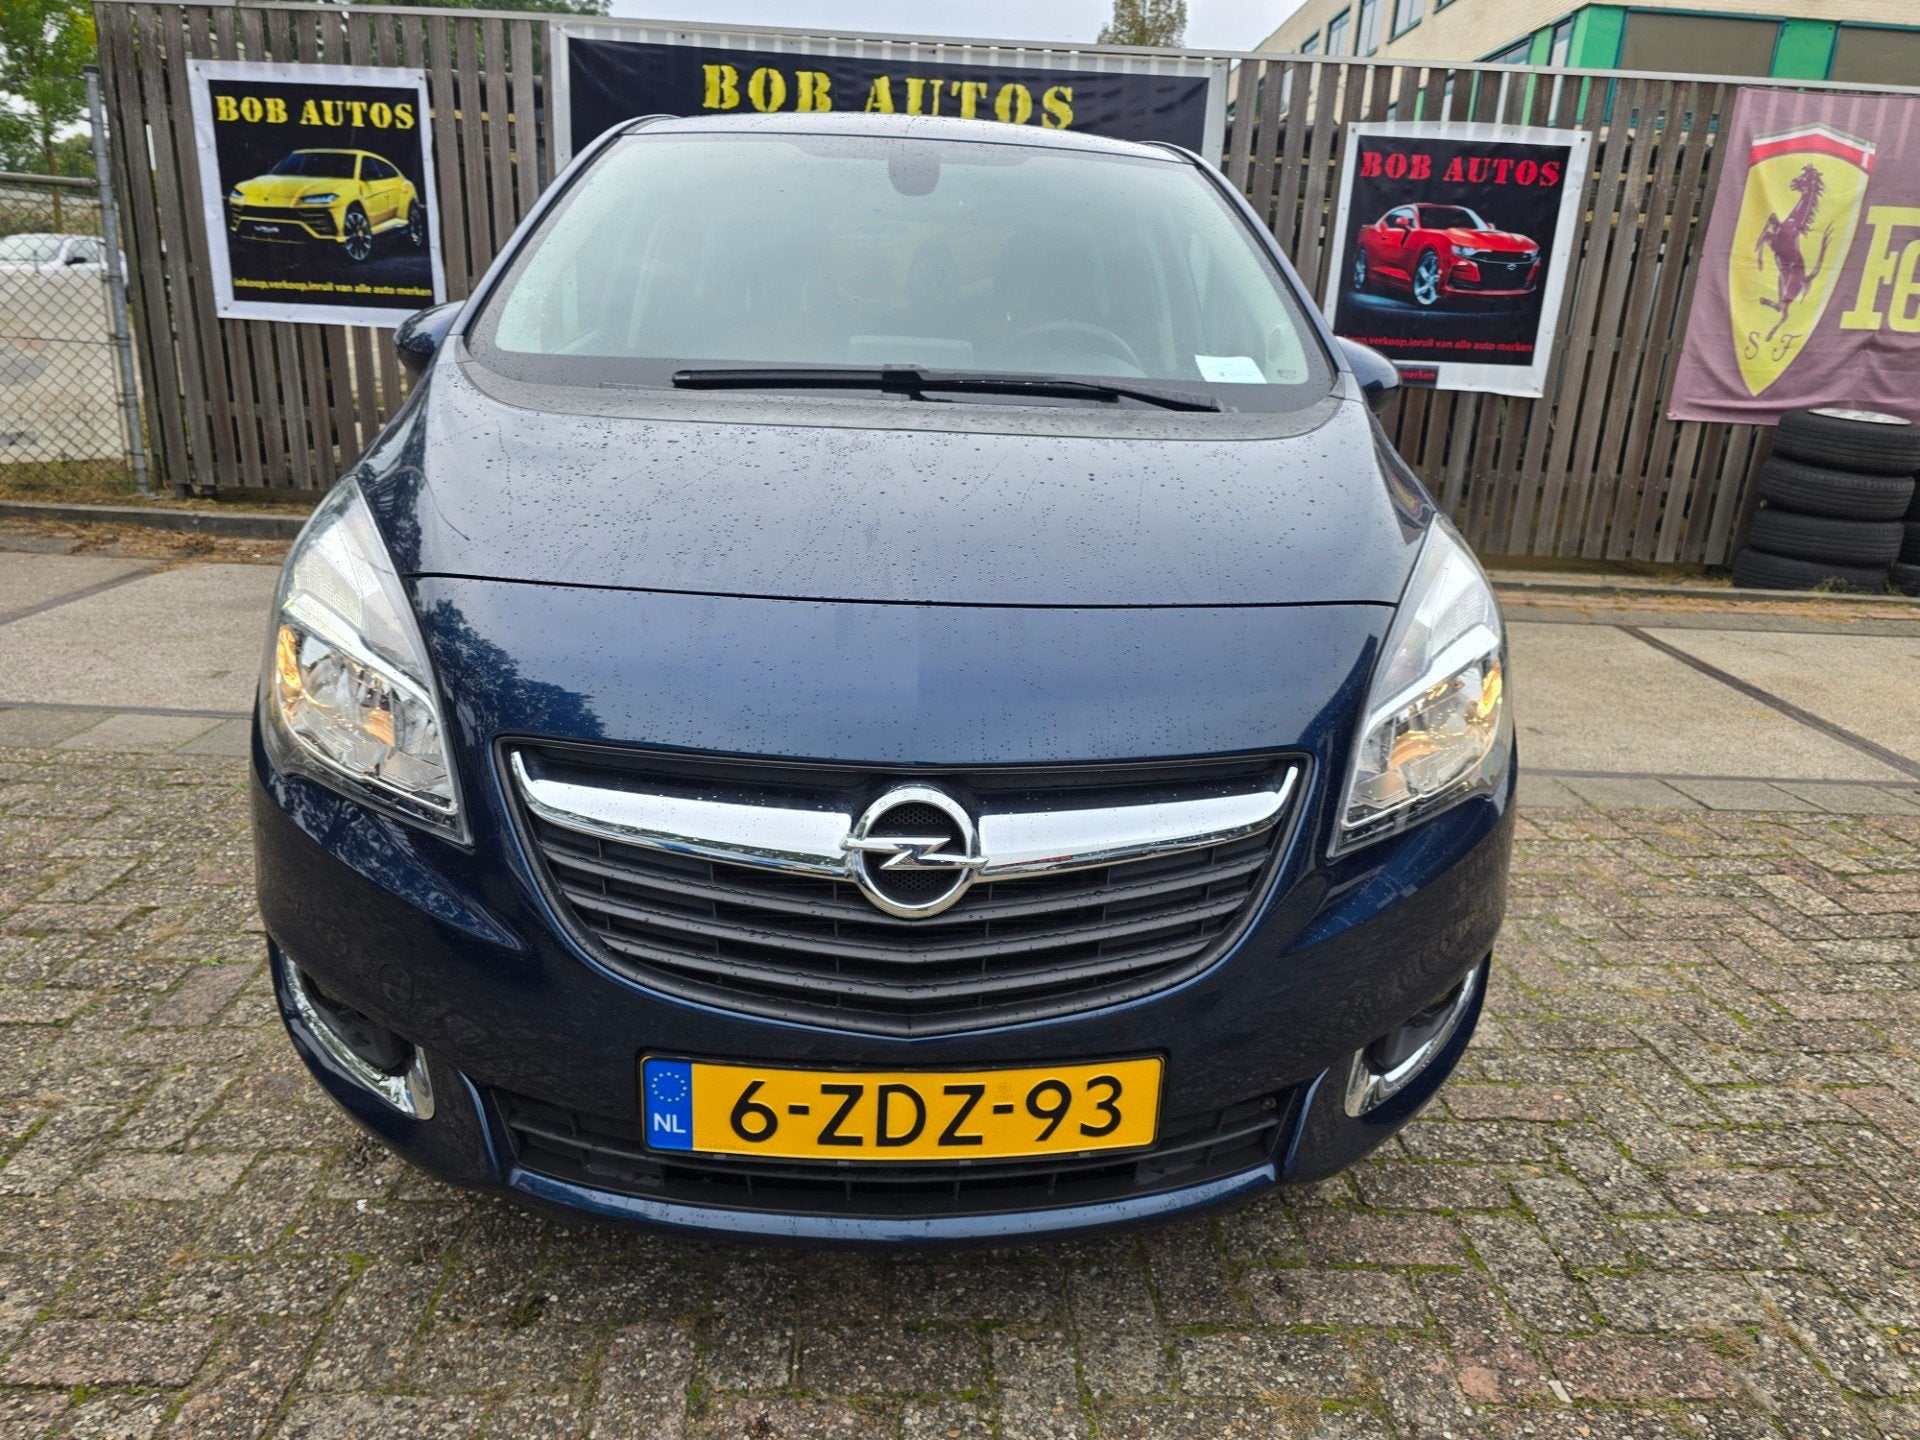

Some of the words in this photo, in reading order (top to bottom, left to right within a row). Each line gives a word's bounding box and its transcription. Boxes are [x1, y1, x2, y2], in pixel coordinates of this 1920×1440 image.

[215, 95, 288, 124] BOB
[299, 99, 415, 130] AUTOS
[703, 63, 832, 113] BOB
[864, 75, 1074, 130] AUTOS
[1359, 151, 1432, 180] BOB
[1443, 156, 1561, 187] AUTOS
[1436, 340, 1453, 349] van
[1454, 339, 1472, 350] alle
[1473, 341, 1496, 351] auto
[1496, 342, 1533, 352] merken
[1744, 331, 1760, 360] S
[653, 1112, 687, 1134] NL
[729, 1075, 1123, 1148] 6-ZDZ-93
